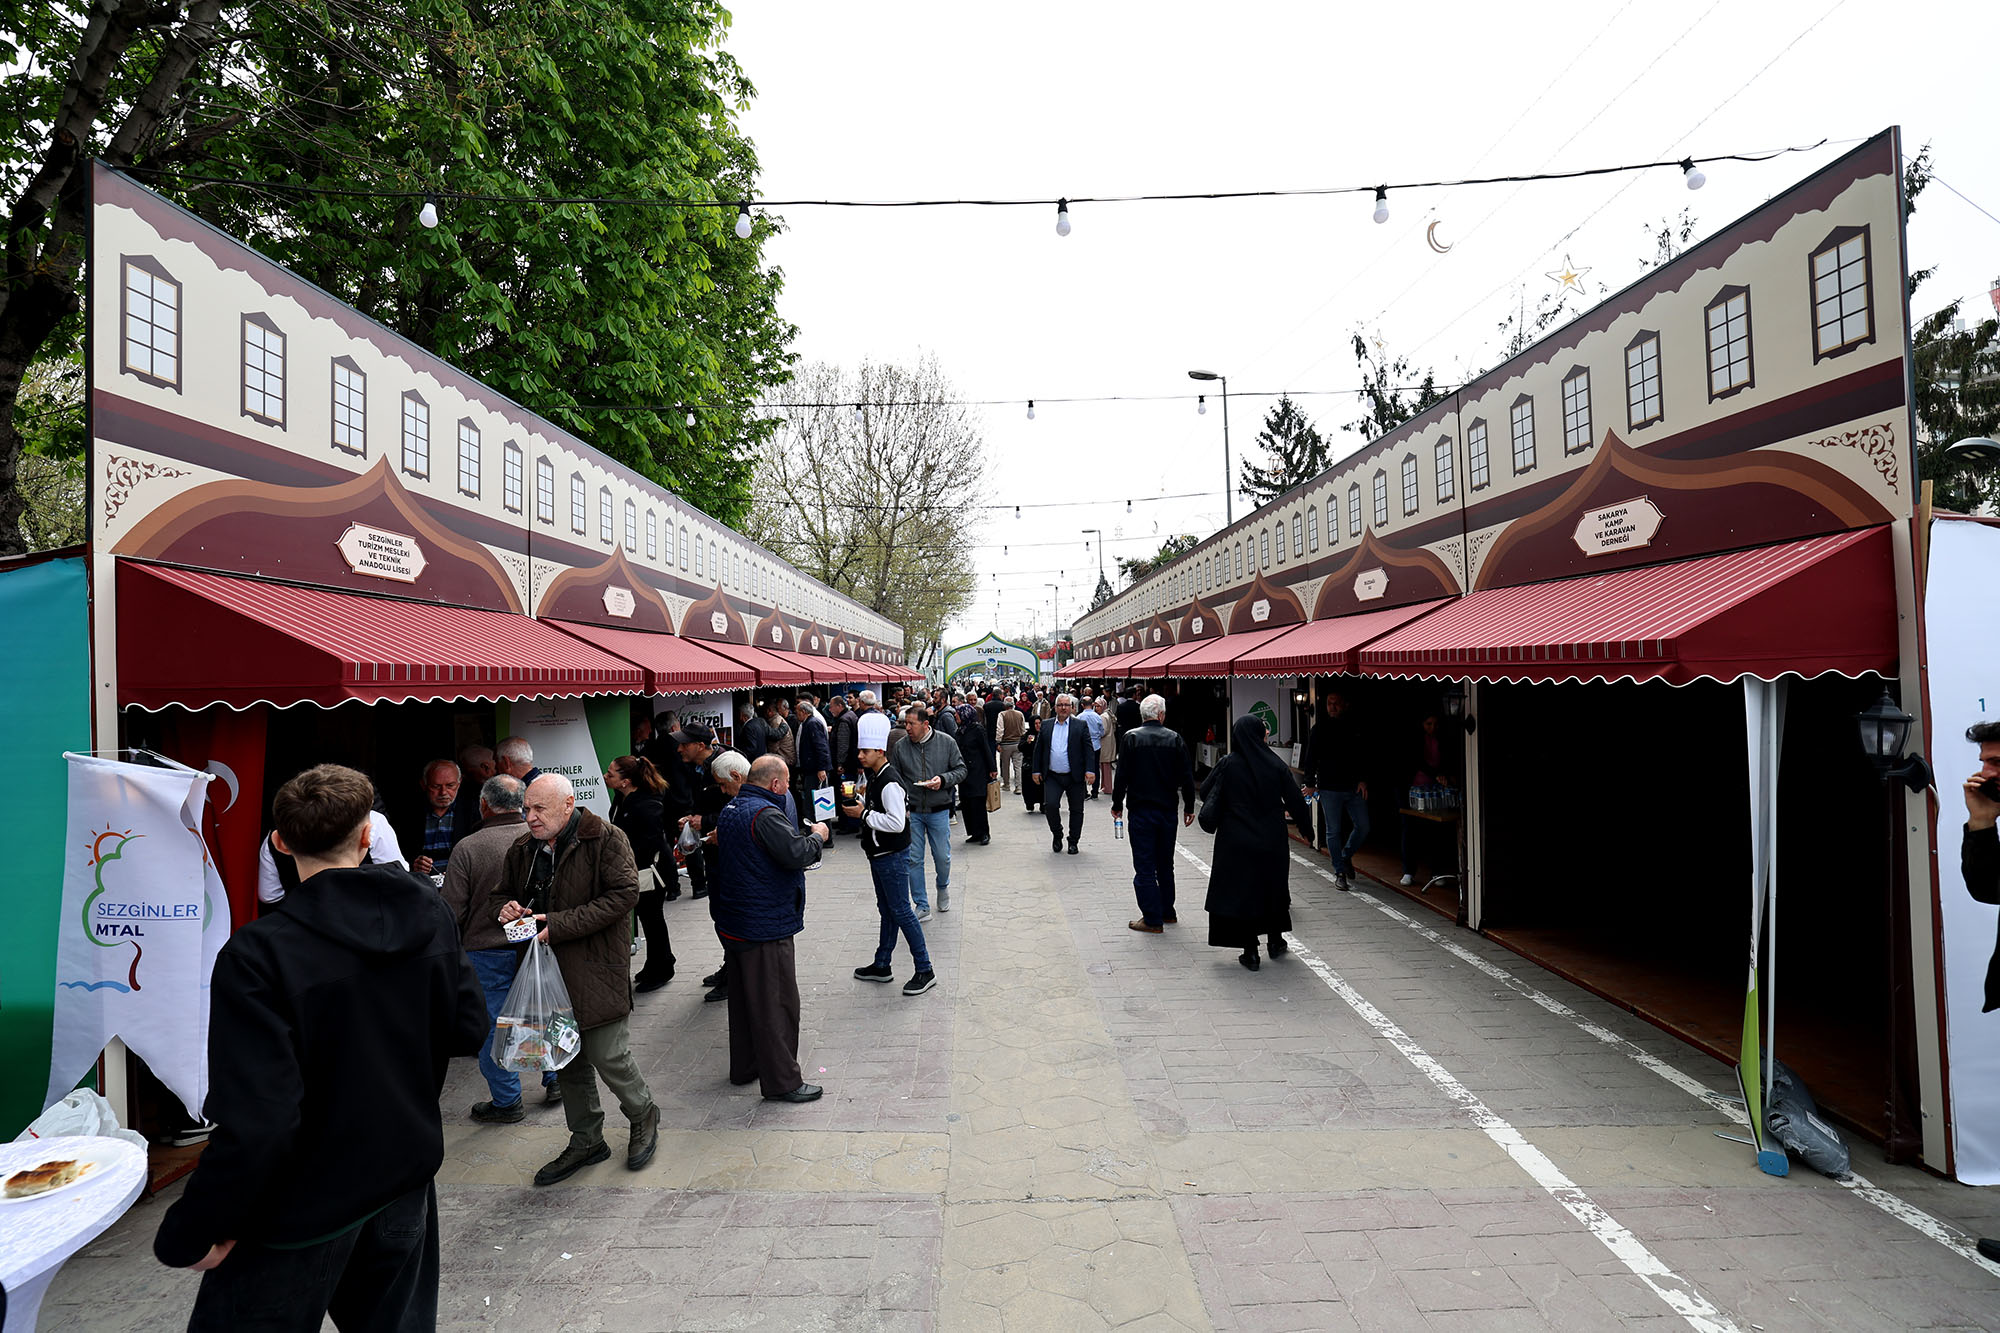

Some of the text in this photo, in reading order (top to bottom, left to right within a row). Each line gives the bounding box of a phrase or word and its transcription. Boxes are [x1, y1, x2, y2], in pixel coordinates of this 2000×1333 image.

[1597, 508, 1628, 522] SAKARYA
[1594, 524, 1636, 540] VE KARAVAN
[1604, 518, 1624, 534] KAMP
[368, 533, 403, 548] SEZGİNLER
[1601, 533, 1630, 547] DERNEĞİ
[358, 540, 410, 558] TURİZM MESLEKİ
[368, 552, 402, 565] VE TEKNİK
[358, 559, 411, 576] ANADOLU LİSESİ
[976, 646, 1007, 654] TURİZM
[1978, 697, 1986, 713] 1
[572, 776, 600, 788] TEKNİK
[97, 901, 199, 917] SEZGİNLER
[95, 923, 145, 937] MTAL
